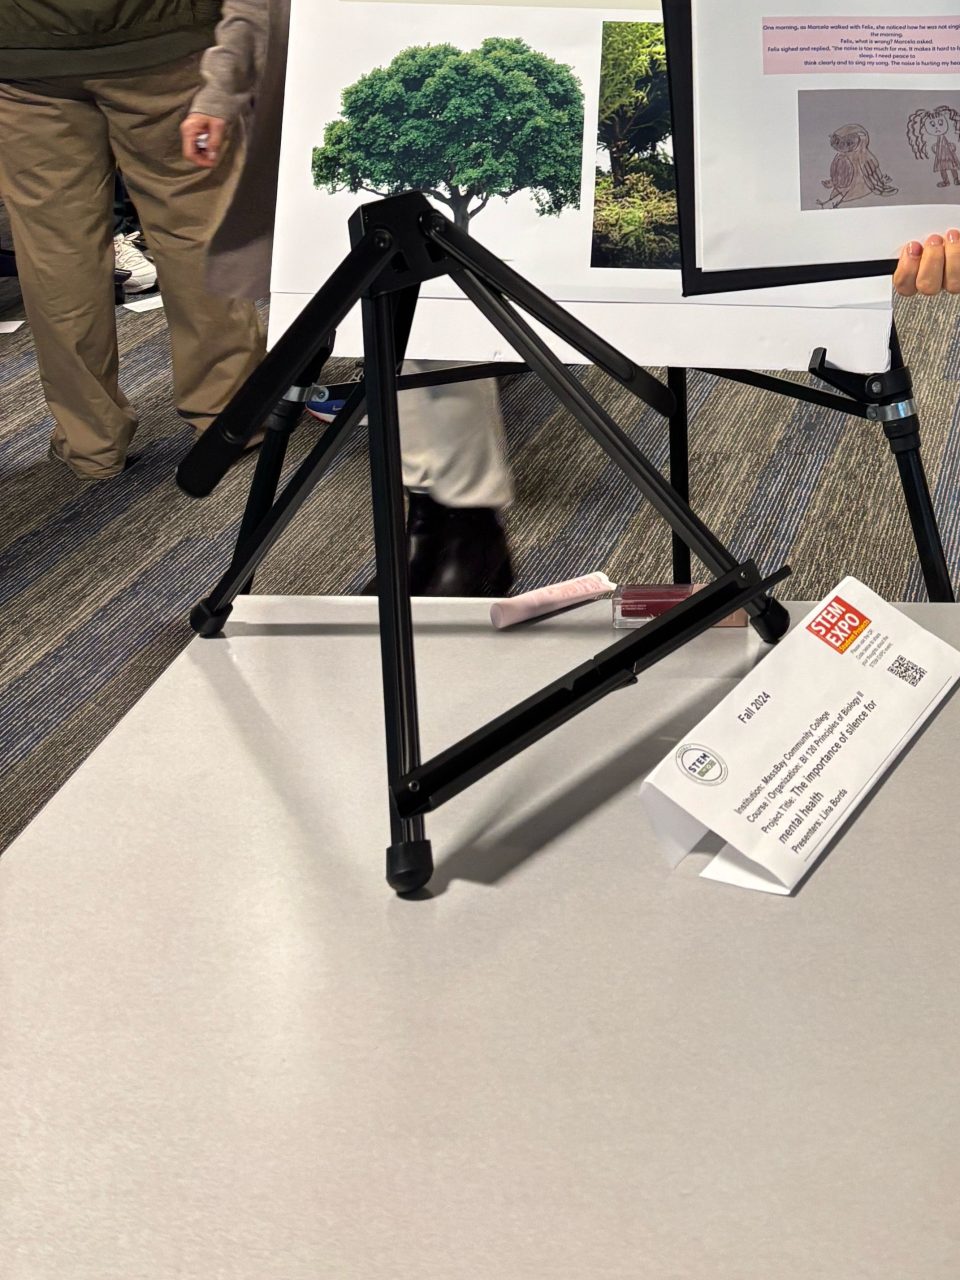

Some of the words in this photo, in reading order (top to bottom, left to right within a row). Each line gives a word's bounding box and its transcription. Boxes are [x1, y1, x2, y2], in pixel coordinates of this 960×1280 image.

[810, 601, 847, 635] STEM
[825, 612, 860, 648] EXPO
[737, 707, 756, 724] Fall
[750, 691, 771, 711] 2024
[837, 712, 844, 722] of
[840, 696, 862, 716] Biology
[813, 720, 840, 747] Principles
[688, 753, 710, 773] STEM
[734, 784, 765, 815] Institution:
[761, 759, 788, 785] MassBay
[783, 729, 814, 761] Community
[809, 711, 830, 731] College
[761, 811, 784, 834] Project
[778, 797, 796, 812] Title:
[790, 781, 808, 797] The
[804, 742, 842, 783] importance
[838, 732, 848, 743] of
[845, 711, 868, 736] silence
[864, 700, 877, 713] for
[805, 744, 818, 757] 120
[767, 763, 803, 799] Organization:
[746, 801, 769, 823] Course
[778, 813, 804, 844] mental
[799, 792, 824, 817] health
[791, 818, 823, 854] Presenters:
[819, 805, 834, 820] Lina
[829, 789, 848, 807] Borda
